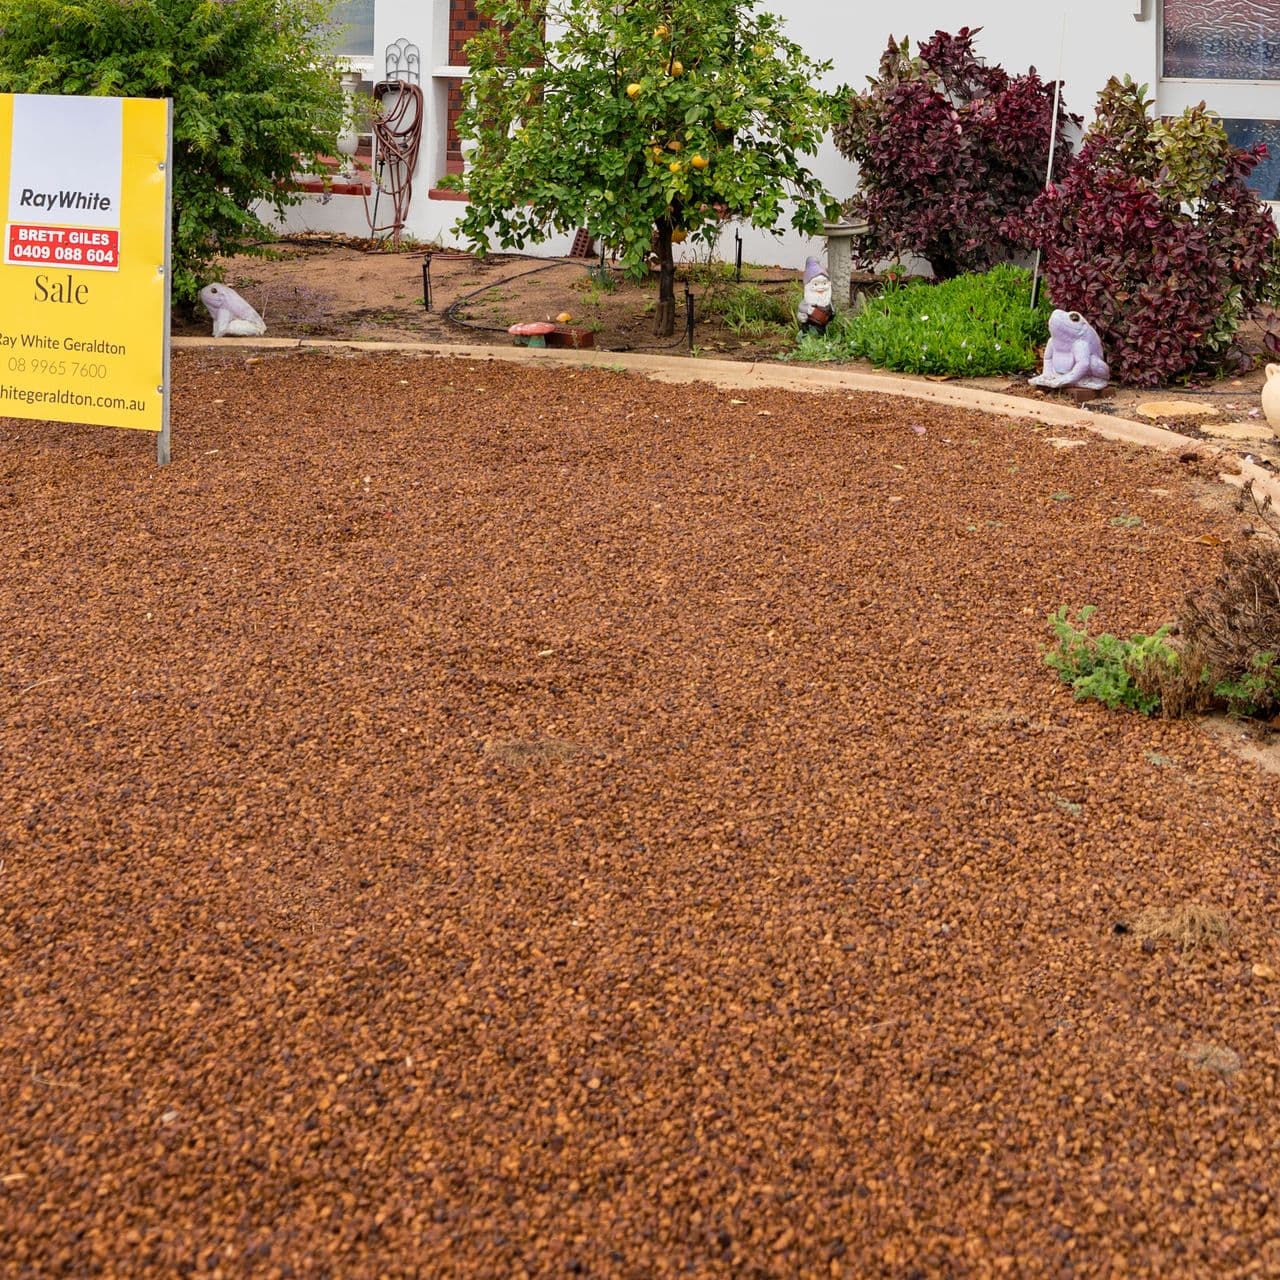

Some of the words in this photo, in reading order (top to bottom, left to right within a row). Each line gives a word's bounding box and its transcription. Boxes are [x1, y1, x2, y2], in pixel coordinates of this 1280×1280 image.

[18, 229, 65, 242] BRETT
[68, 232, 110, 245] GILES
[14, 245, 49, 259] 0409
[54, 247, 82, 261] 088
[86, 249, 114, 263] 604
[34, 274, 89, 305] Sale
[20, 334, 60, 350] White
[63, 337, 126, 355] Geraldton
[8, 357, 27, 372] 08
[31, 359, 66, 376] 9965
[71, 362, 107, 379] 7600
